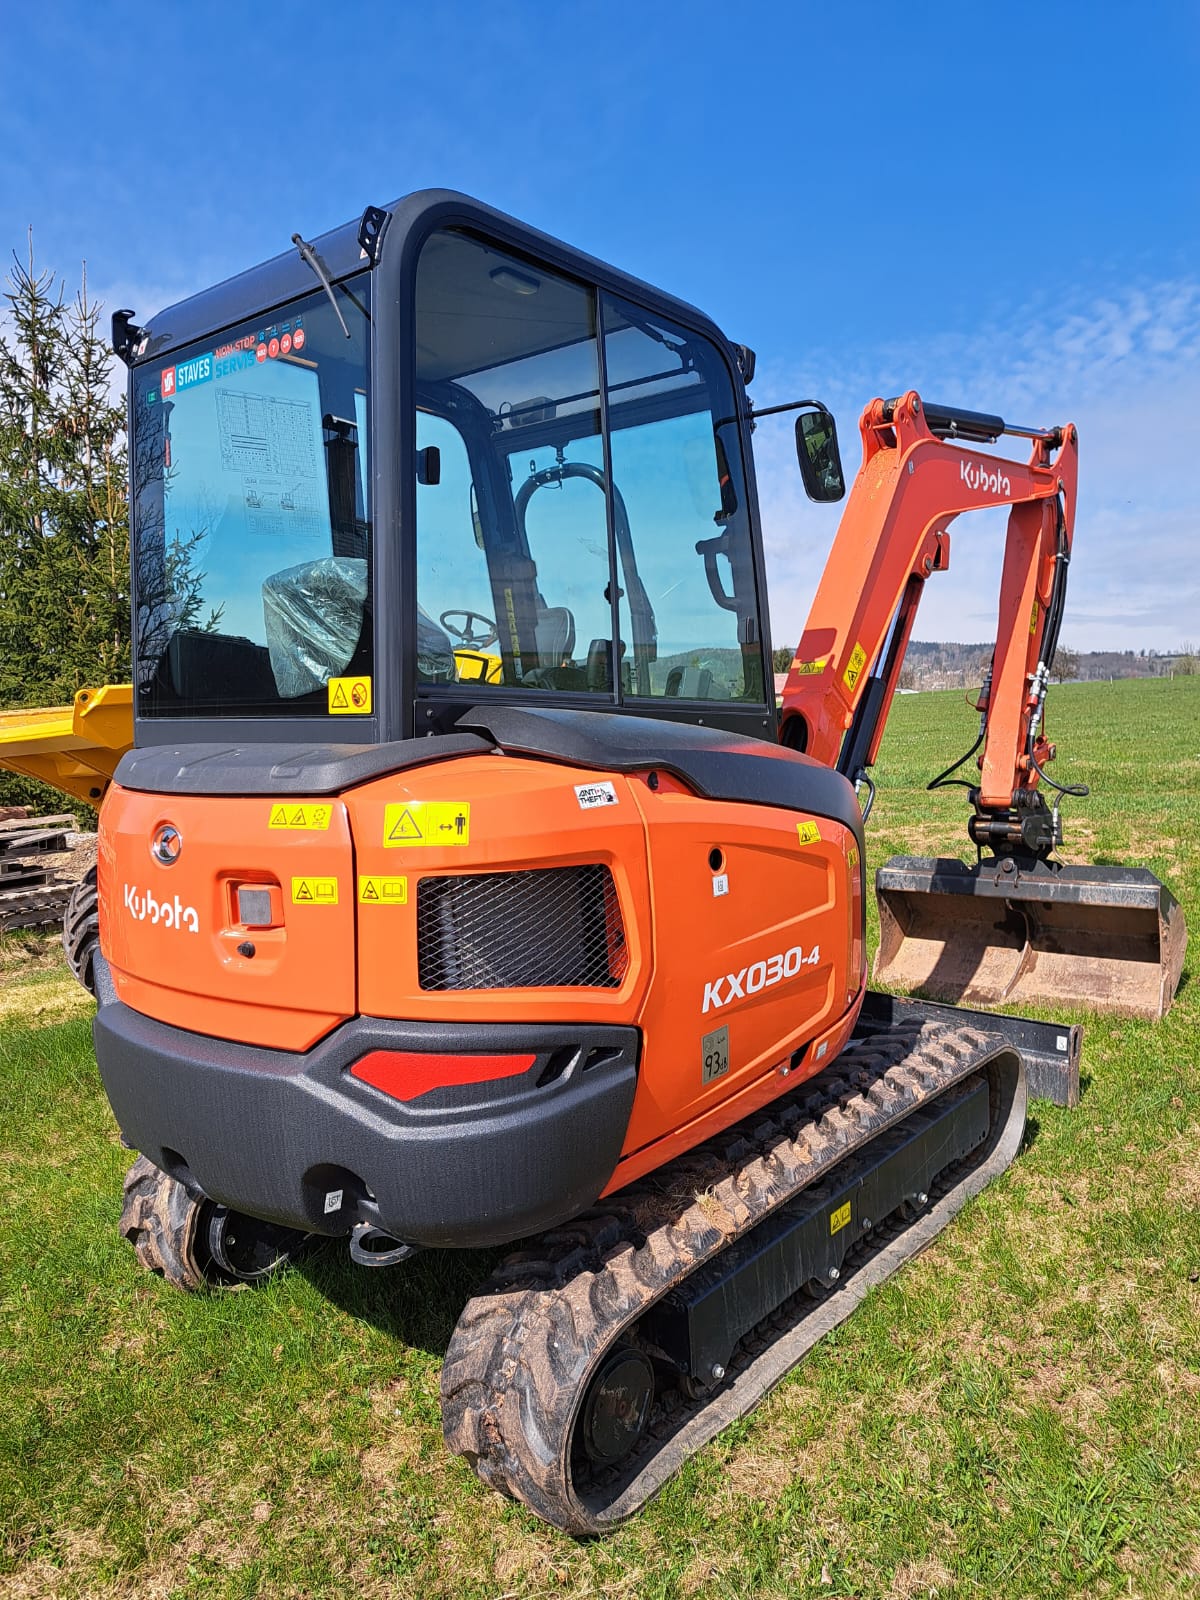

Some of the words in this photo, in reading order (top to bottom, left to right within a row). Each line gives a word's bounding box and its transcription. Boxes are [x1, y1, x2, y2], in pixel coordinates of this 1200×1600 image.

[215, 335, 256, 359] NON-STOP
[178, 358, 210, 386] STAVES
[215, 350, 256, 378] SERVIS
[960, 459, 1011, 496] Kubota
[580, 794, 603, 804] THEFT
[124, 883, 199, 933] Kubota
[702, 945, 820, 1014] KX030-4
